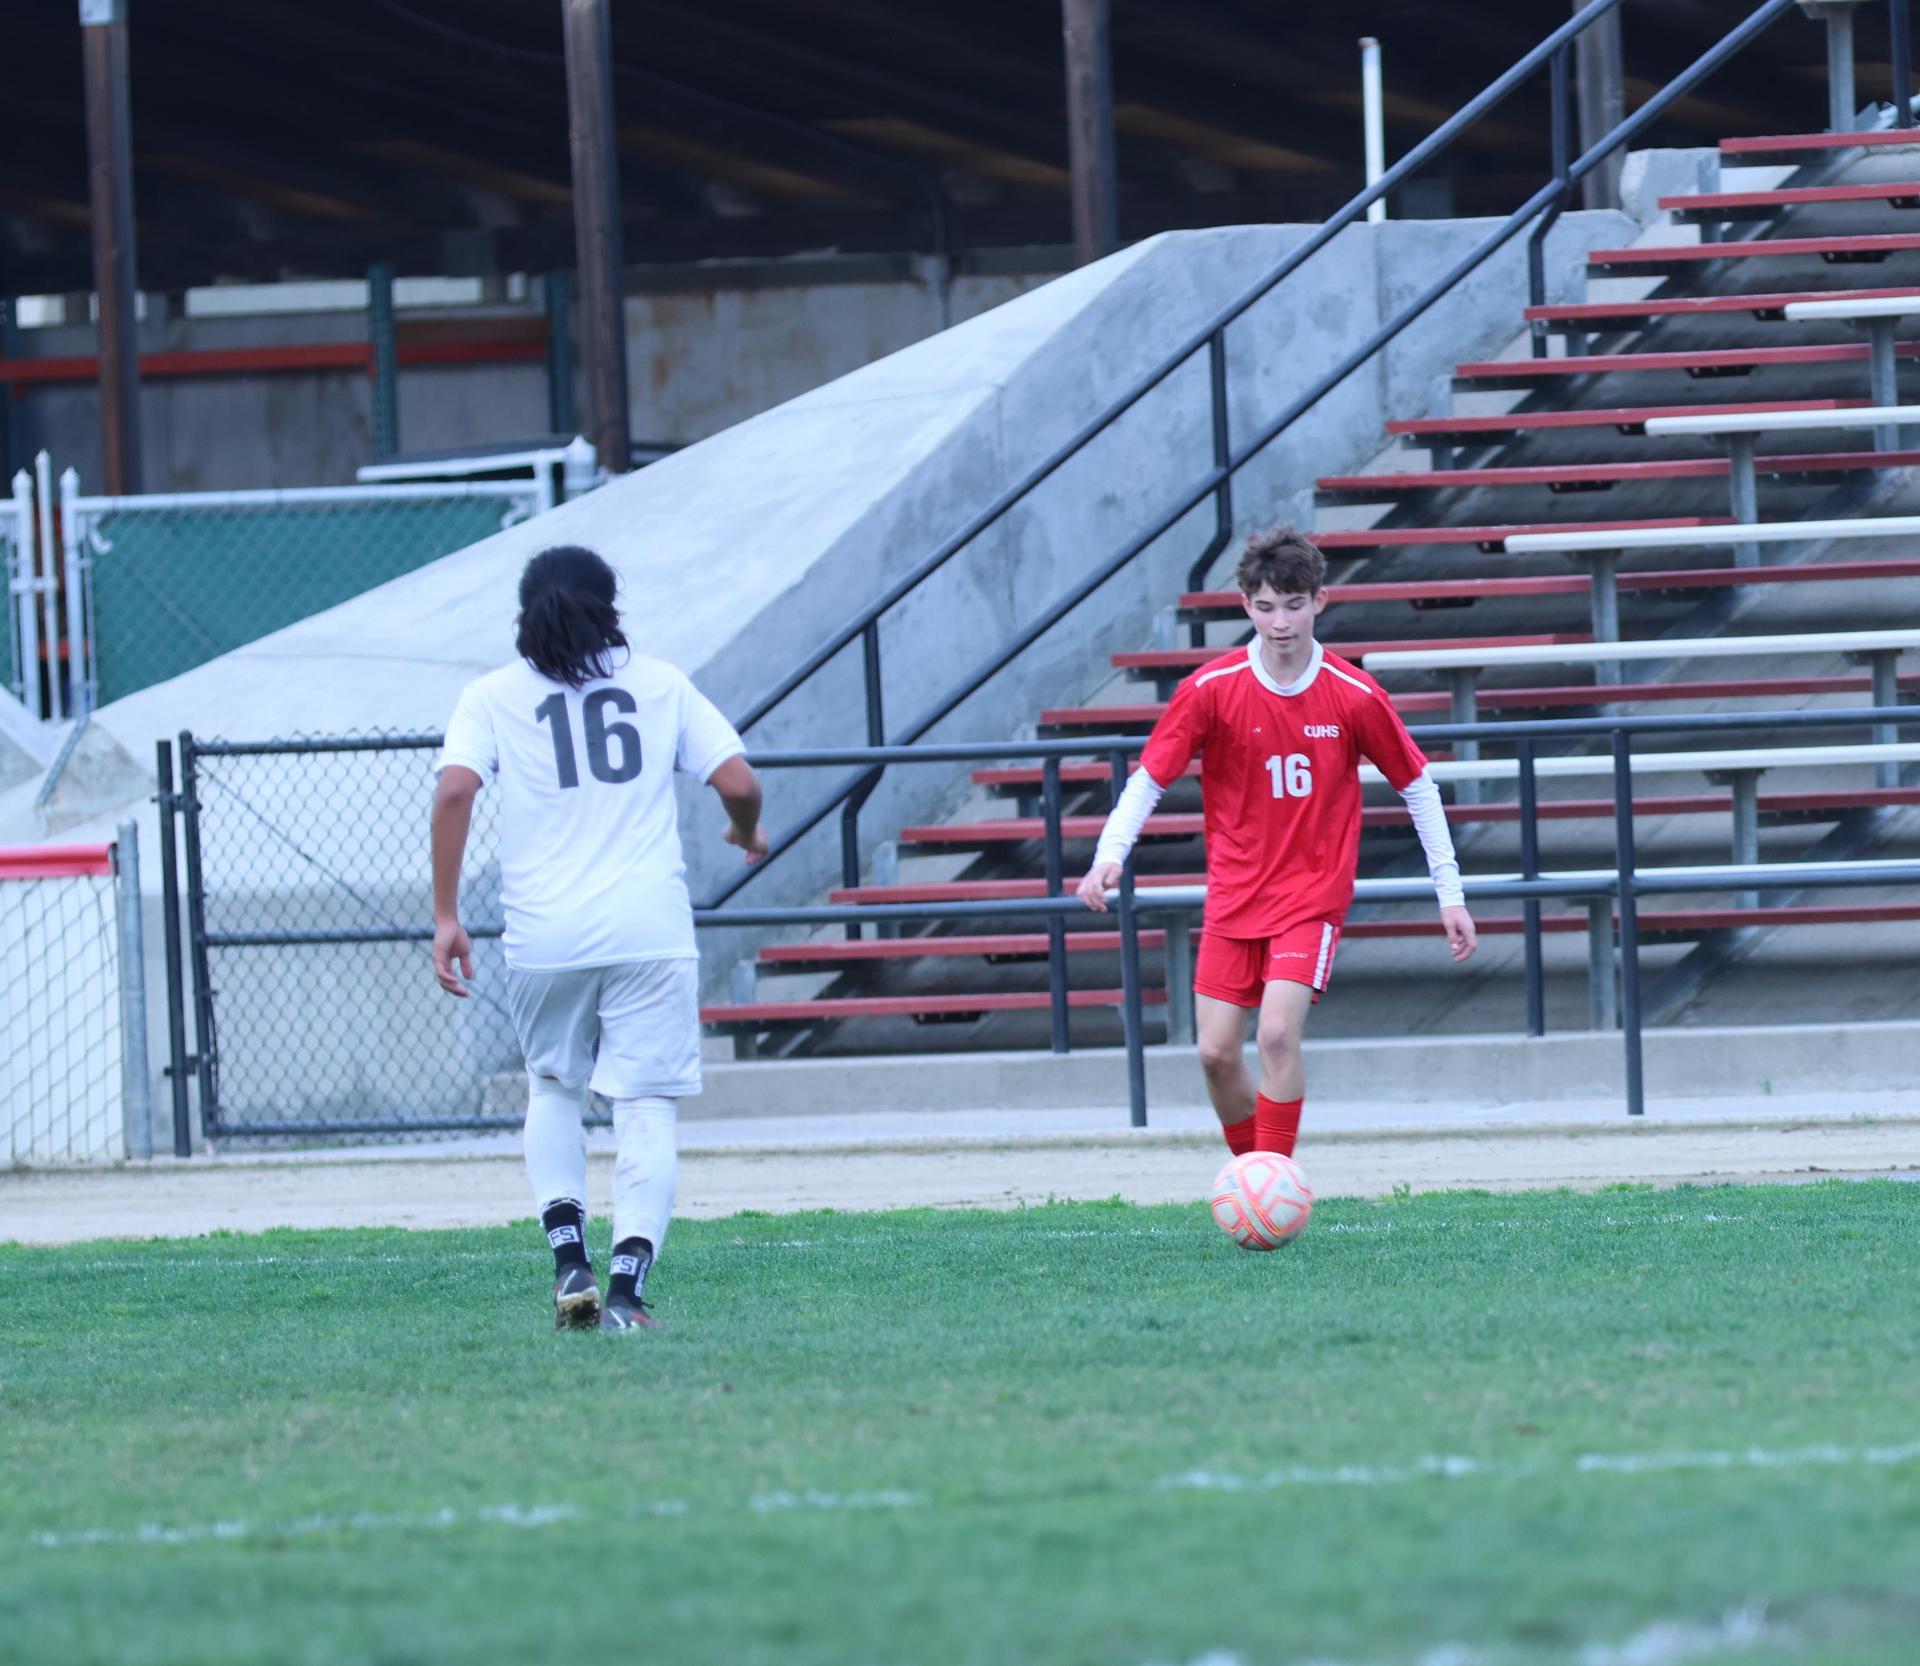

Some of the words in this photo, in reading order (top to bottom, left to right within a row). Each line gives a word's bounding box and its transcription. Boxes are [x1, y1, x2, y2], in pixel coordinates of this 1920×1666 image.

[534, 686, 642, 790] 16
[1265, 752, 1313, 799] 16
[549, 1227, 575, 1246] FS
[611, 1257, 634, 1273] FS
